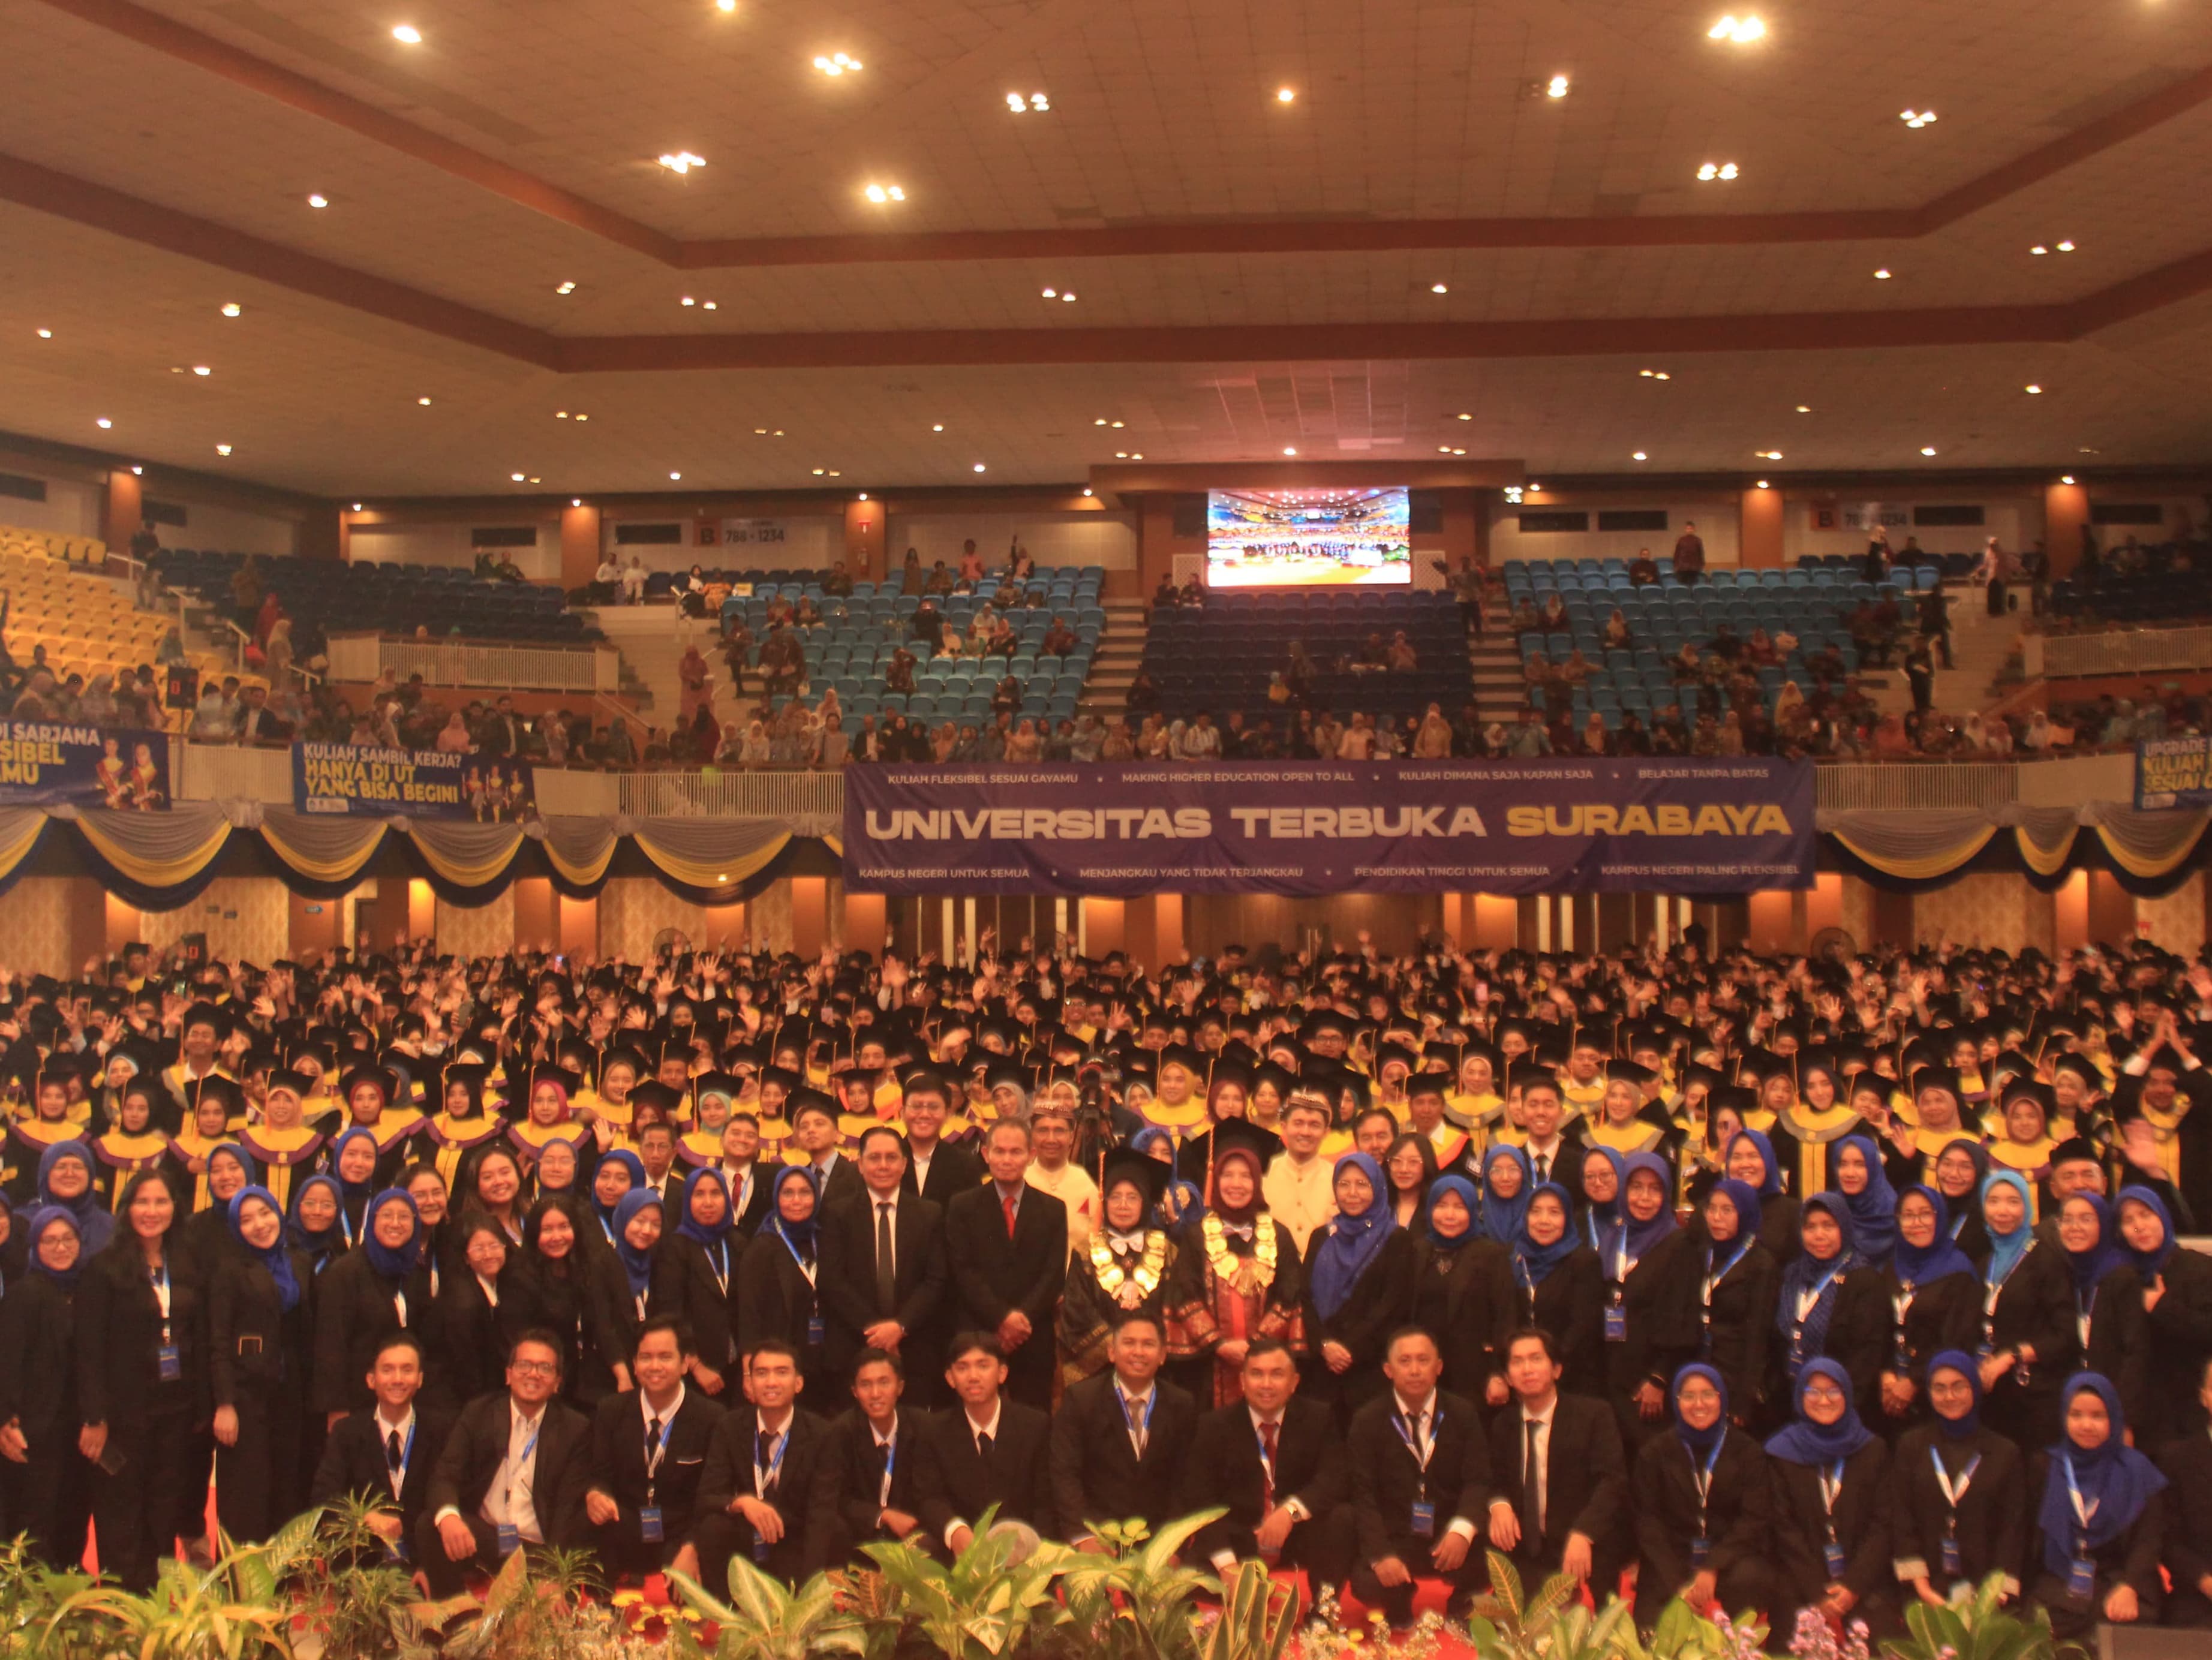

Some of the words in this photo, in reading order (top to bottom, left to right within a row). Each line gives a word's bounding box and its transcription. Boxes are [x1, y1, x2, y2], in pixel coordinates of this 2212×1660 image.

[1819, 511, 1832, 527] B
[701, 528, 714, 544] B
[758, 529, 785, 543] 1234
[14, 722, 101, 746] SARJANA
[2145, 738, 2206, 756] UPGRADE
[303, 744, 356, 761] KULIAH
[360, 747, 411, 765] SAMBIL
[414, 751, 462, 768] KERJA?
[305, 759, 367, 780] HANYA
[371, 763, 389, 782] DI
[394, 765, 416, 783] UT
[2144, 754, 2205, 775] KULIAH
[0, 762, 39, 785] MU
[888, 775, 928, 784] KULIAH
[931, 775, 987, 784] FLEKSIBEL
[990, 774, 1028, 783] SESUAI
[1031, 774, 1078, 783] GAYAMU
[1122, 772, 1167, 783] MAKING
[1170, 772, 1211, 782] HIGHER
[1215, 772, 1279, 781] EDUCATION
[1282, 772, 1313, 781] OPEN
[1317, 772, 1331, 781] TO
[1333, 772, 1354, 781] ALL
[1399, 771, 1441, 780] KULIAH
[1444, 771, 1490, 780] DIMANA
[1492, 771, 1520, 780] SAJA
[1523, 771, 1562, 779] KAPAN
[1564, 770, 1594, 779] SAJA
[1639, 769, 1689, 778] BELAJAR
[1691, 769, 1729, 778] TANPA
[1732, 768, 1769, 778] BATAS
[305, 777, 357, 797] YANG
[359, 780, 400, 801] BISA
[404, 784, 458, 804] BEGINI
[2144, 773, 2200, 793] SESUAI
[865, 808, 1212, 840] UNIVERSITAS
[1231, 807, 1487, 838] TERBUKA
[1507, 805, 1792, 837] SURABAYA
[859, 870, 905, 878] KAMPUS
[908, 870, 948, 878] NEGERI
[950, 869, 988, 878] UNTUK
[990, 869, 1030, 877] SEMUA
[1080, 869, 1158, 878] MENJANGKAU
[1160, 868, 1191, 877] YANG
[1193, 868, 1227, 877] TIDAK
[1230, 868, 1303, 877] TERJANGKAU
[1354, 867, 1425, 877] PENDIDIKAN
[1427, 867, 1465, 876] TINGGI
[1468, 867, 1507, 876] UNTUK
[1510, 867, 1550, 876] SEMUA
[1601, 865, 1649, 875] KAMPUS
[1652, 865, 1694, 874] NEGERI
[1697, 865, 1738, 874] PALING
[1741, 865, 1800, 874] FLEKSIBEL
